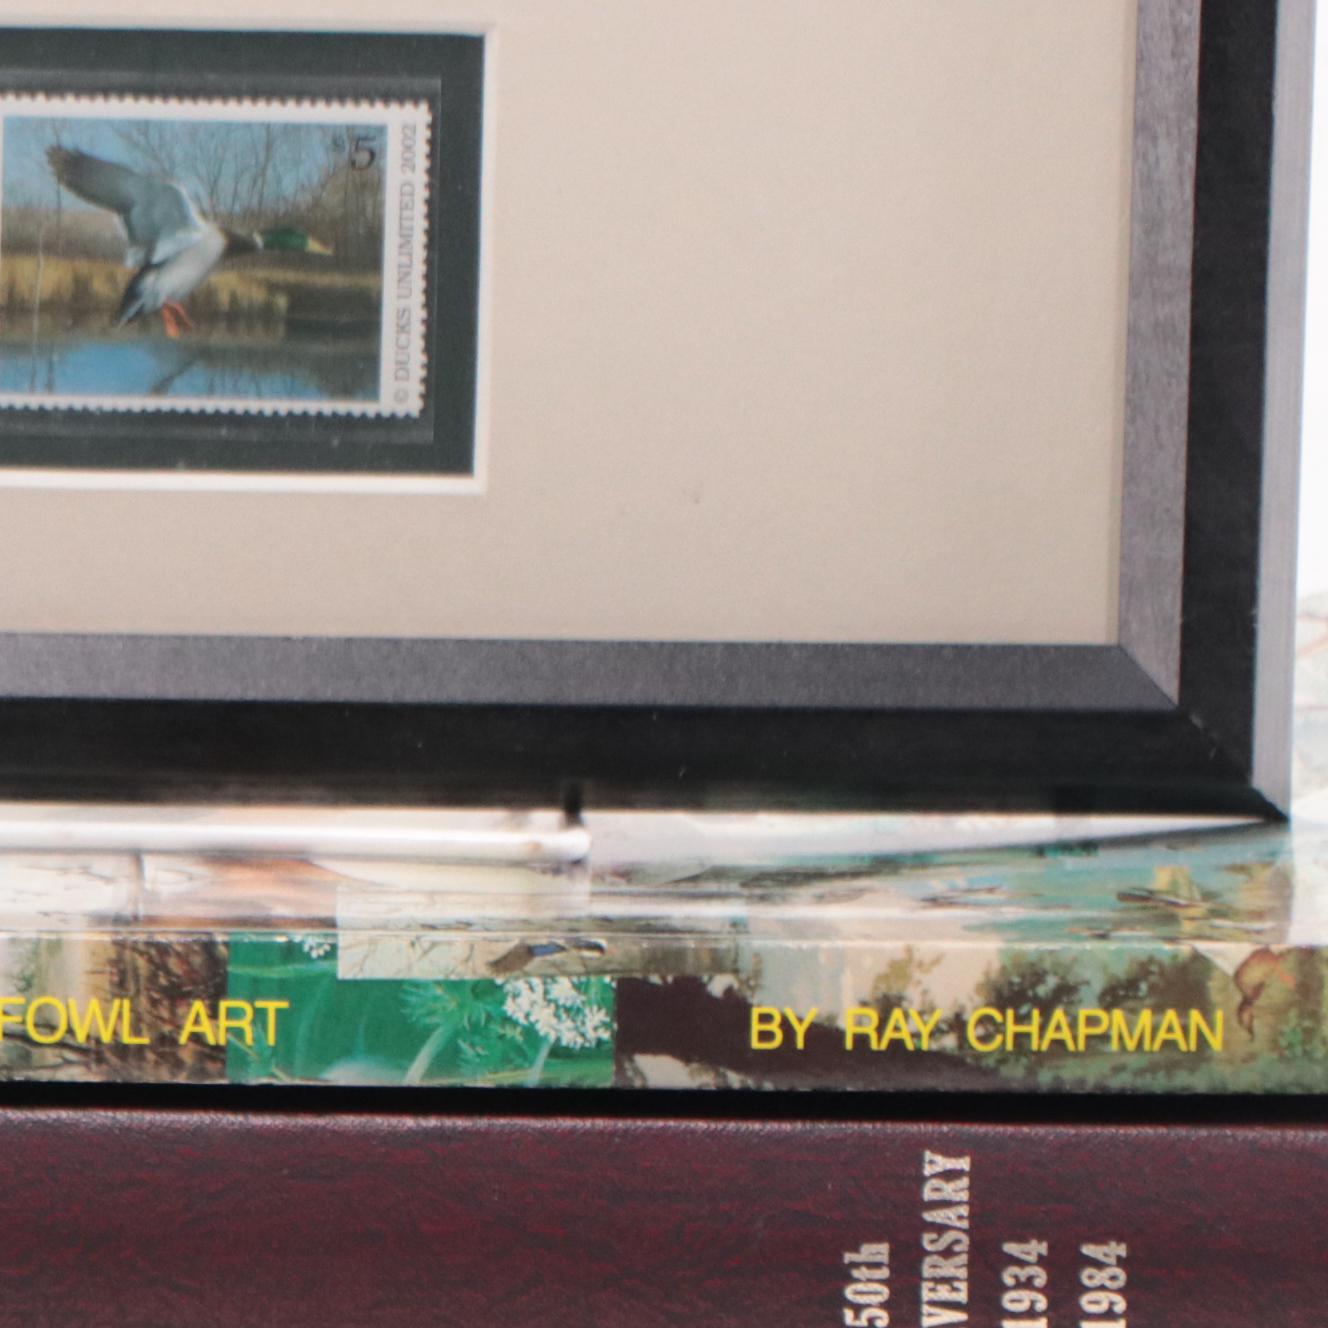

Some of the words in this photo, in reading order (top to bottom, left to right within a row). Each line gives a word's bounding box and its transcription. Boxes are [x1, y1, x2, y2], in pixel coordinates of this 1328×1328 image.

[400, 124, 417, 174] 2002
[396, 181, 415, 300] UNLIMITED
[394, 306, 412, 382] DUCKS
[178, 999, 290, 1047] ART
[750, 1006, 816, 1051] BY
[845, 1006, 942, 1052] RAY
[967, 1007, 1224, 1053] CHAPMAN
[843, 1241, 891, 1328] 50th
